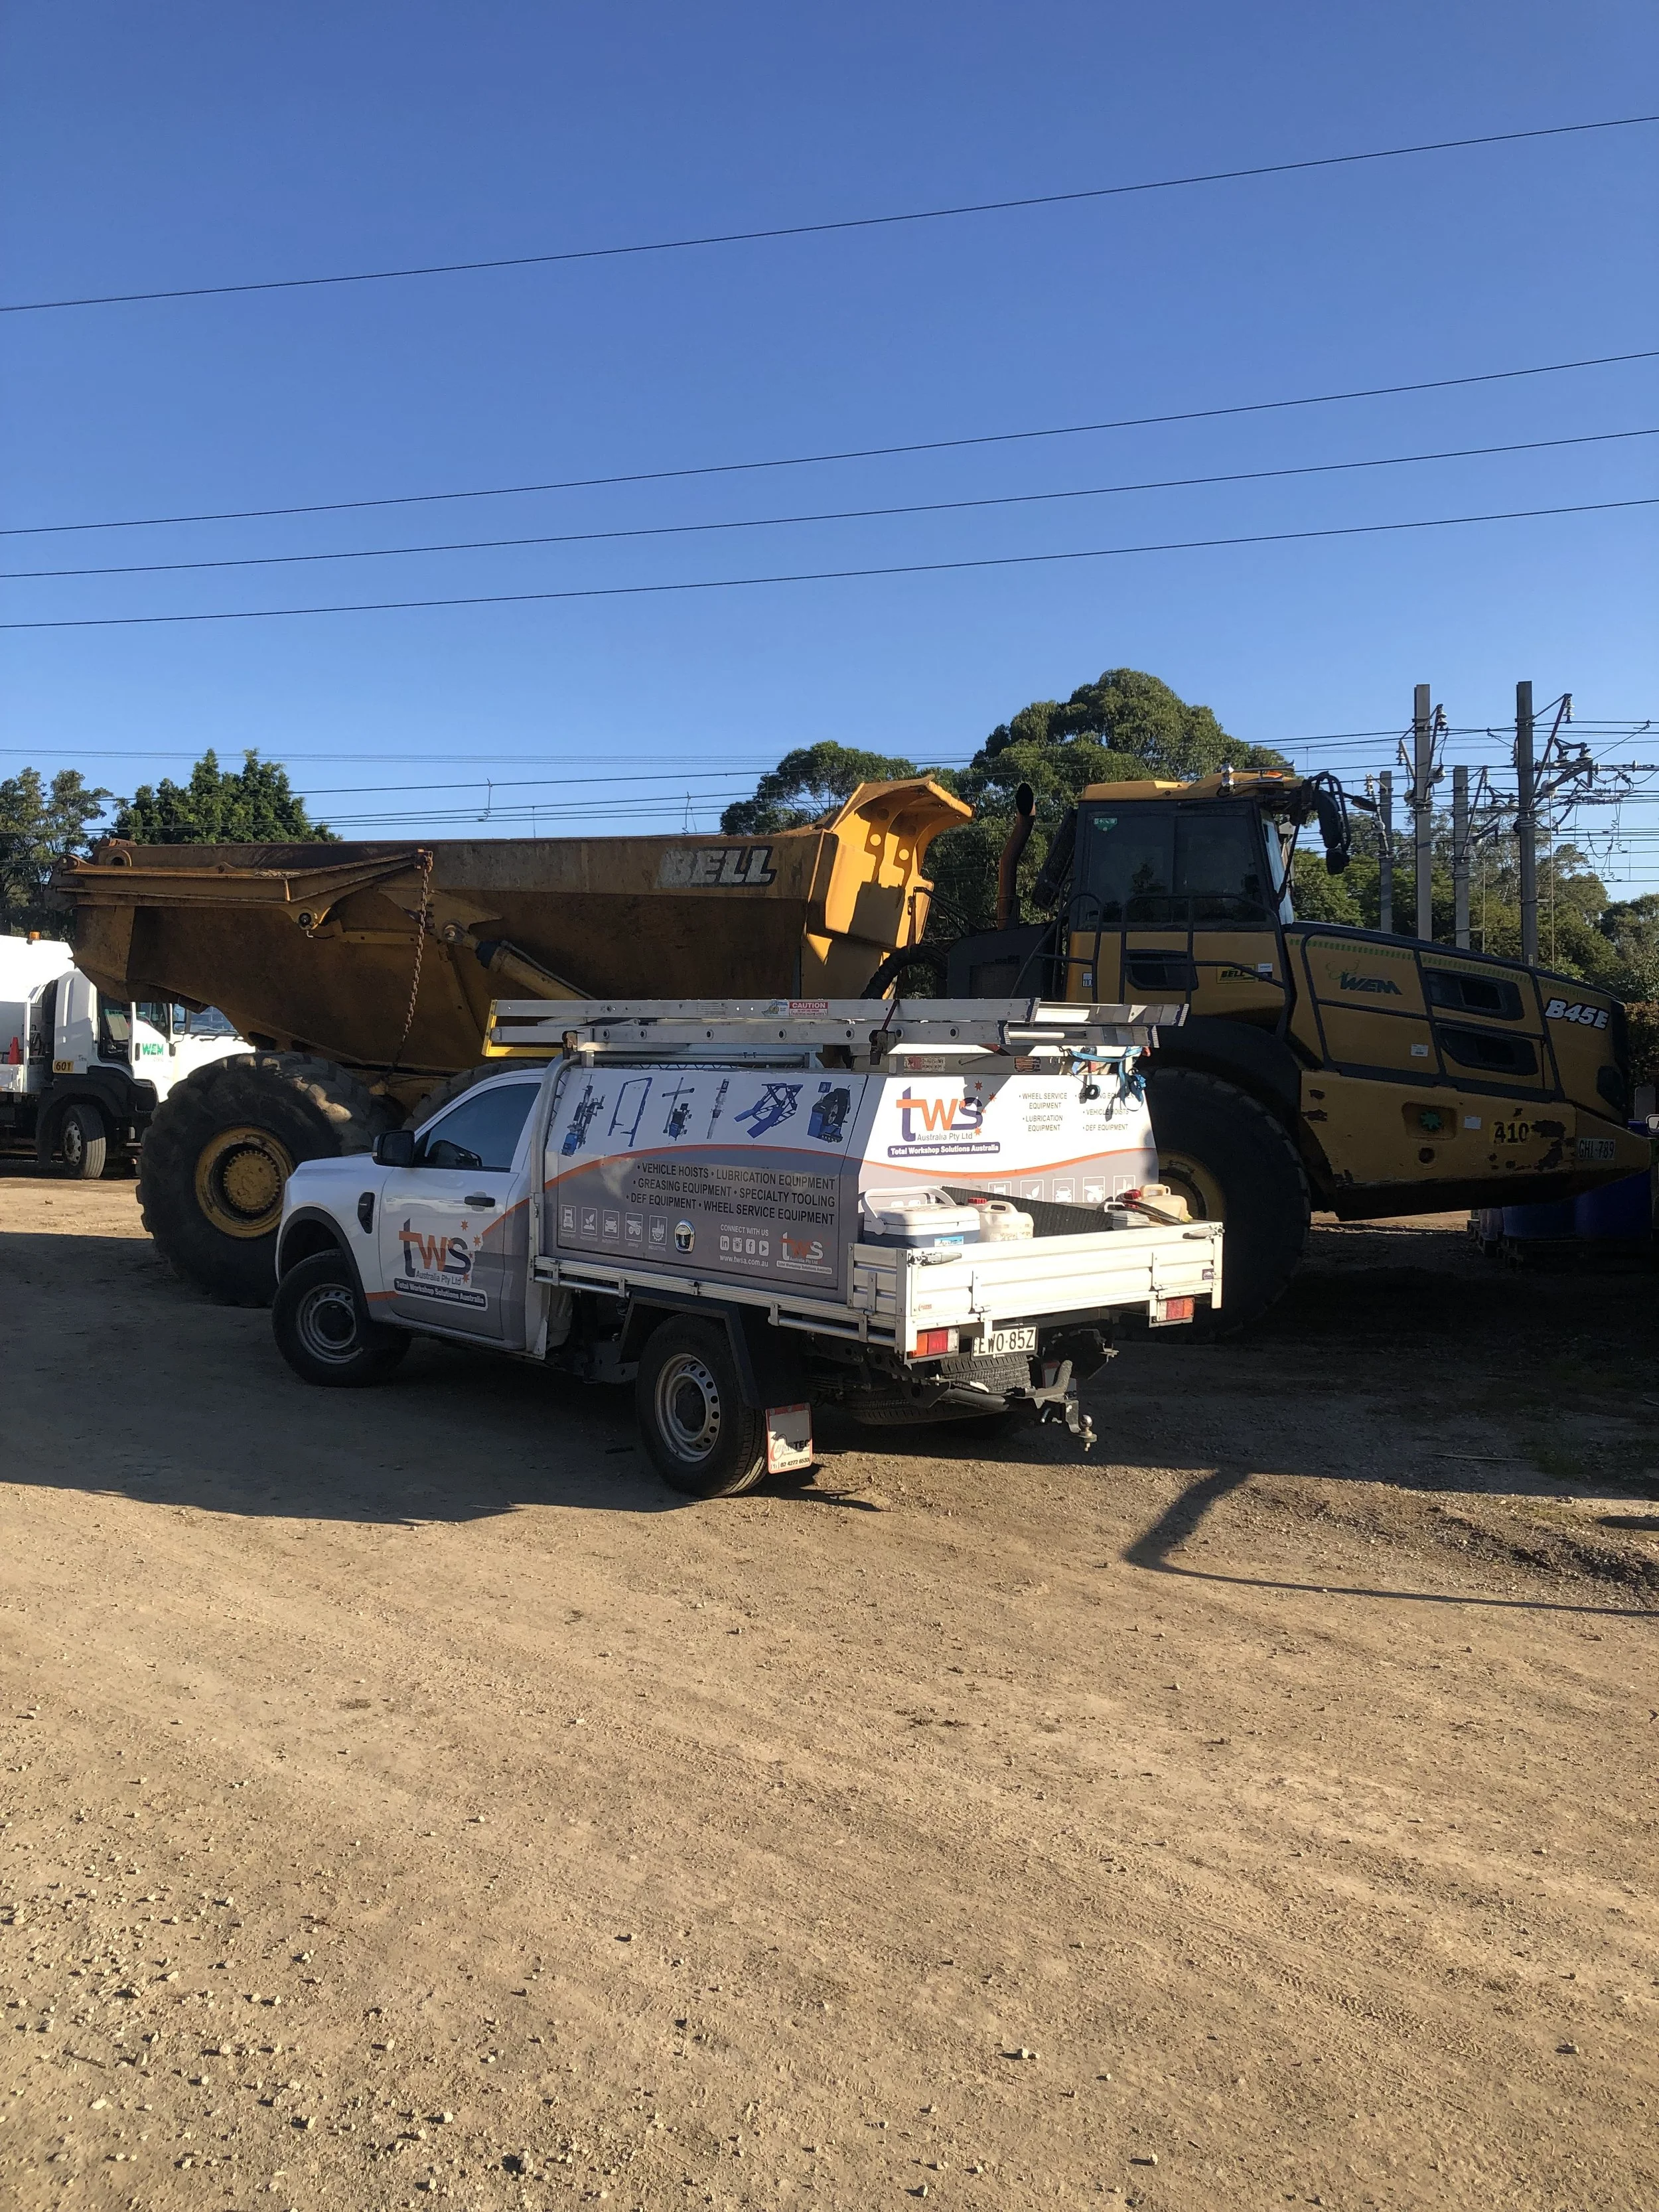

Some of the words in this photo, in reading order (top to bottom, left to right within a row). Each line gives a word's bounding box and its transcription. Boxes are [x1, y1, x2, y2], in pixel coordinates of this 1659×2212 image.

[656, 848, 775, 887] BELL
[1340, 972, 1402, 995] WEM
[1545, 999, 1609, 1029] B45E
[142, 1043, 164, 1055] WEM
[56, 1062, 70, 1071] 601
[917, 1133, 947, 1142] Australia
[949, 1133, 960, 1142] Pty
[891, 1147, 907, 1155] Total
[908, 1146, 940, 1155] Workshop
[941, 1145, 970, 1153] Solutions
[971, 1143, 999, 1152] Australia
[642, 1163, 676, 1175] VEHICLE
[679, 1166, 709, 1179] HOISTS
[717, 1169, 776, 1185] LUBRICATION
[779, 1175, 835, 1190] EQUIPMENT
[638, 1178, 680, 1192] GREASING
[683, 1182, 731, 1196] EQUIPMENT
[739, 1188, 788, 1203] SPECIALTY
[790, 1193, 835, 1208] TOOLING
[631, 1193, 646, 1204] DEF
[649, 1195, 696, 1209] EQUIPMENT
[703, 1200, 734, 1214] WHEEL
[737, 1204, 774, 1218] SERVICE
[778, 1209, 835, 1225] EQUIPMENT
[720, 1224, 745, 1233] CONNECT
[719, 1255, 768, 1267] www.twsa.com.au
[416, 1271, 439, 1282] Australia
[441, 1274, 451, 1285] Pty
[452, 1276, 461, 1286] Ltd
[409, 1283, 435, 1295] Workshop
[435, 1288, 459, 1299] Solutions
[460, 1292, 484, 1303] Australia
